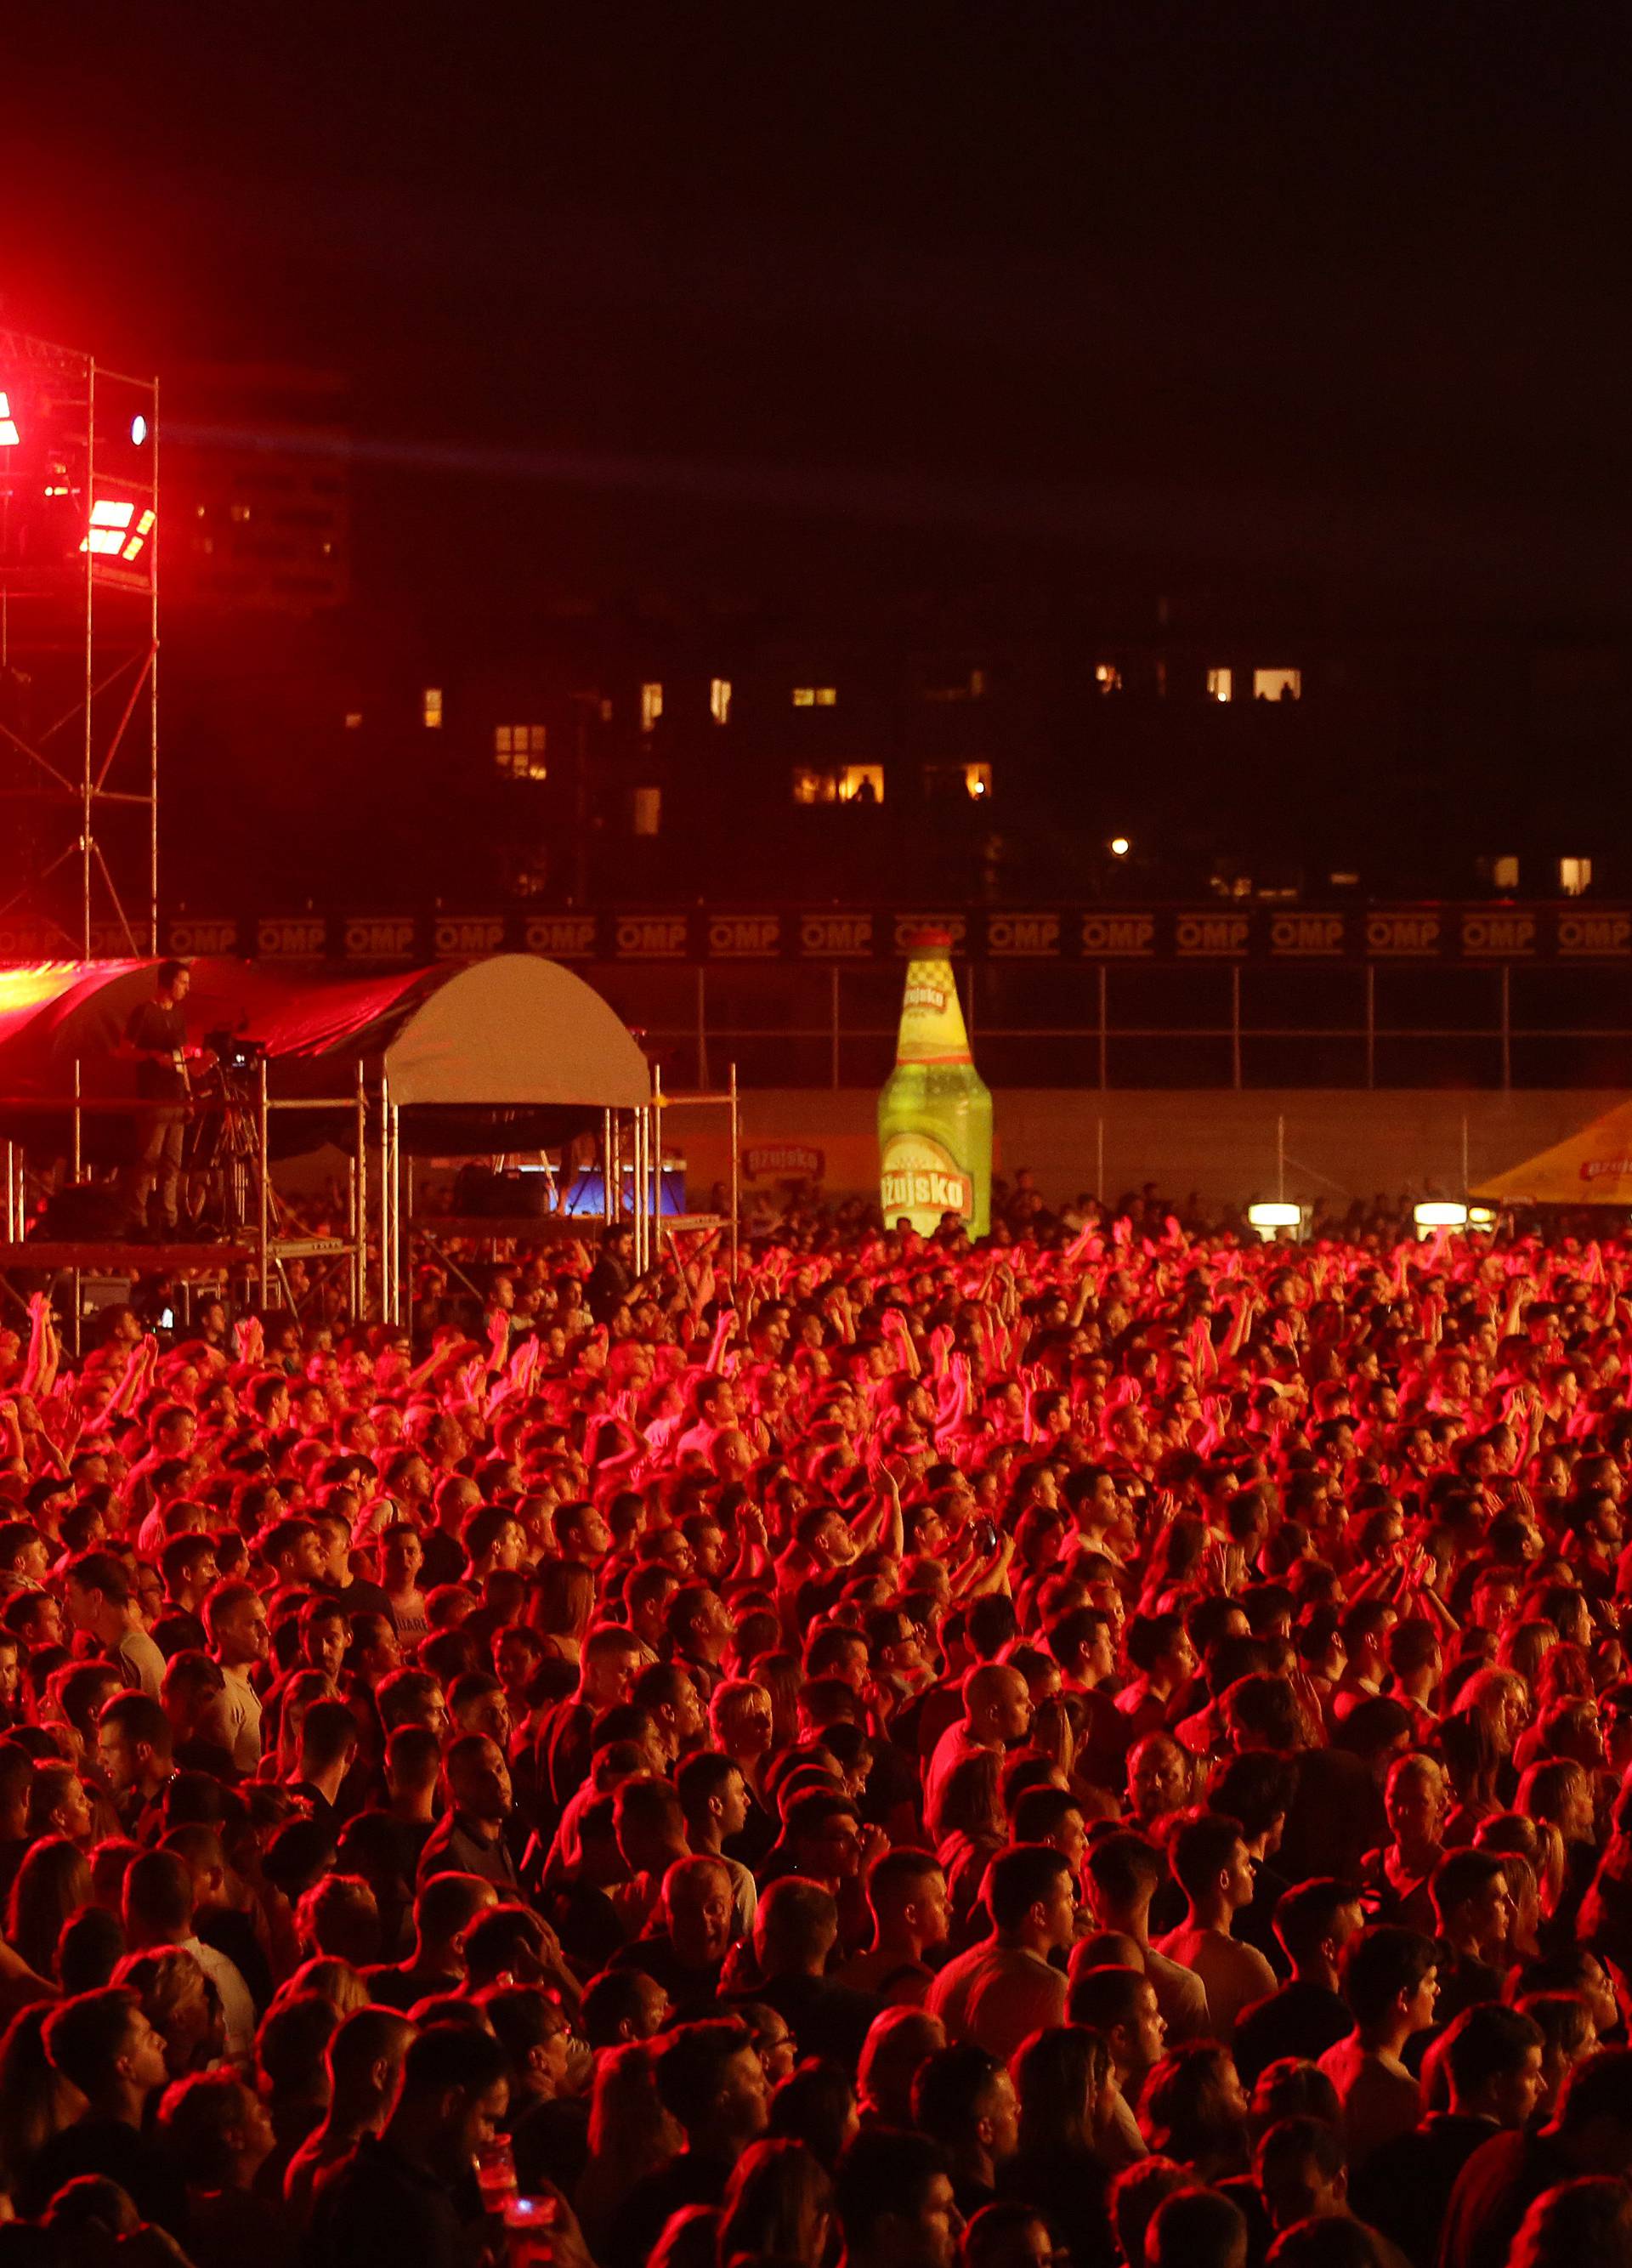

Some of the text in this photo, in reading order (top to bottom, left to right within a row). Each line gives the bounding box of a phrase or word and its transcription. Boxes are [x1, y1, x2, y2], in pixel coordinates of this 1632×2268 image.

[170, 927, 237, 951] OMP
[258, 925, 326, 950] OMP
[346, 924, 415, 950] OMP
[435, 924, 504, 950] OMP
[525, 923, 596, 950] OMP
[616, 923, 688, 950] OMP
[708, 922, 780, 949] OMP
[802, 922, 873, 949] OMP
[988, 921, 1061, 948] OMP
[1082, 921, 1155, 948] OMP
[1176, 921, 1250, 948] OMP
[1271, 921, 1344, 947] OMP
[1366, 921, 1441, 947] OMP
[1461, 921, 1536, 947] OMP
[1557, 921, 1632, 947] OMP
